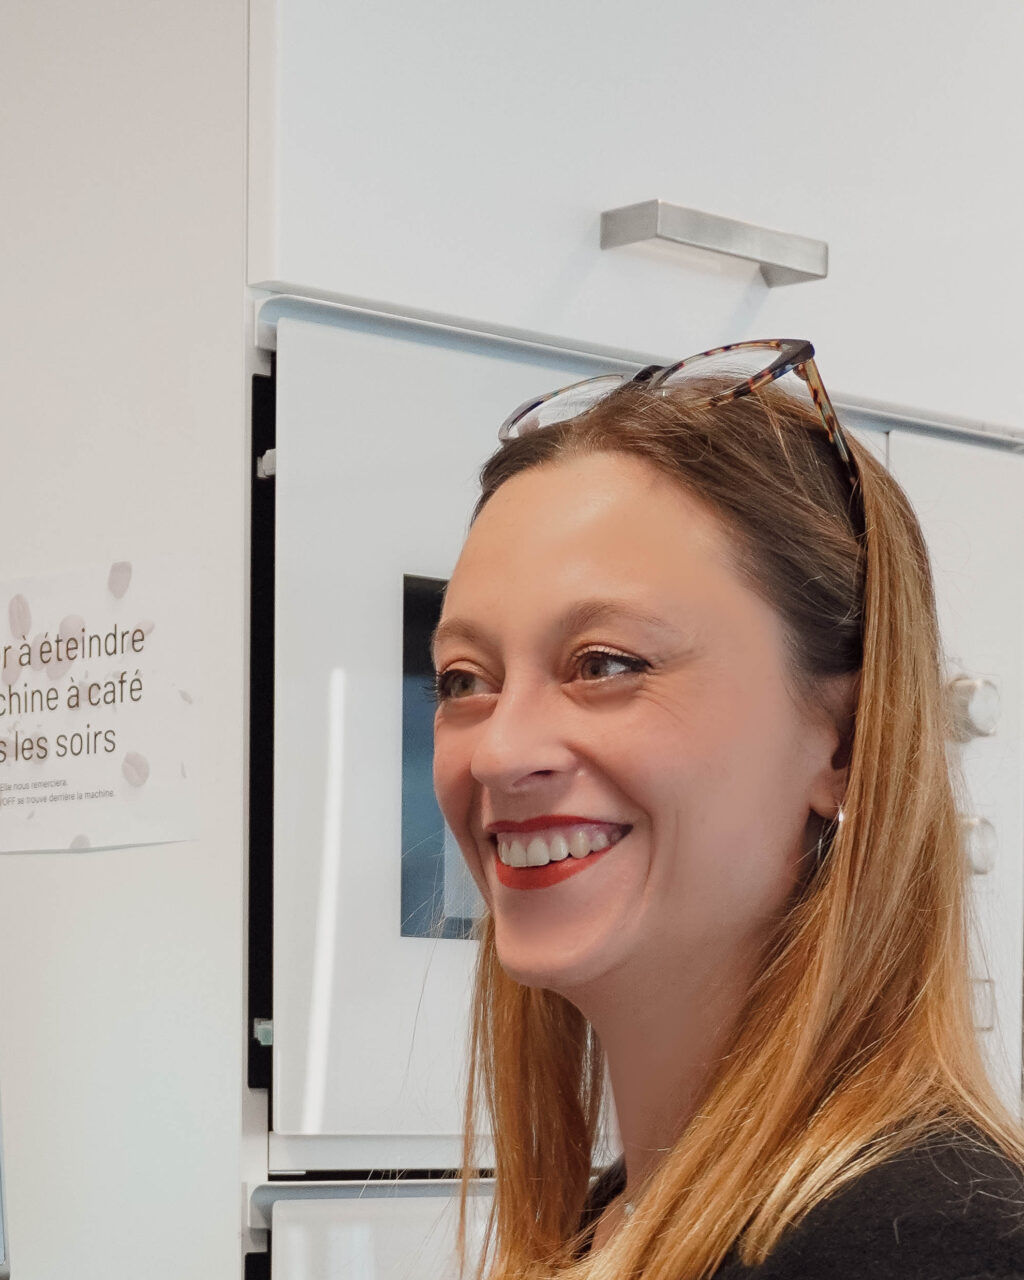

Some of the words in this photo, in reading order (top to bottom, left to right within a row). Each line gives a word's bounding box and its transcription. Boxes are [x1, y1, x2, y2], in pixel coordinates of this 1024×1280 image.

[18, 635, 32, 667] à
[39, 623, 146, 664] éteindre
[66, 676, 80, 709] à
[88, 669, 144, 706] café
[14, 730, 49, 762] les
[55, 723, 117, 757] soirs
